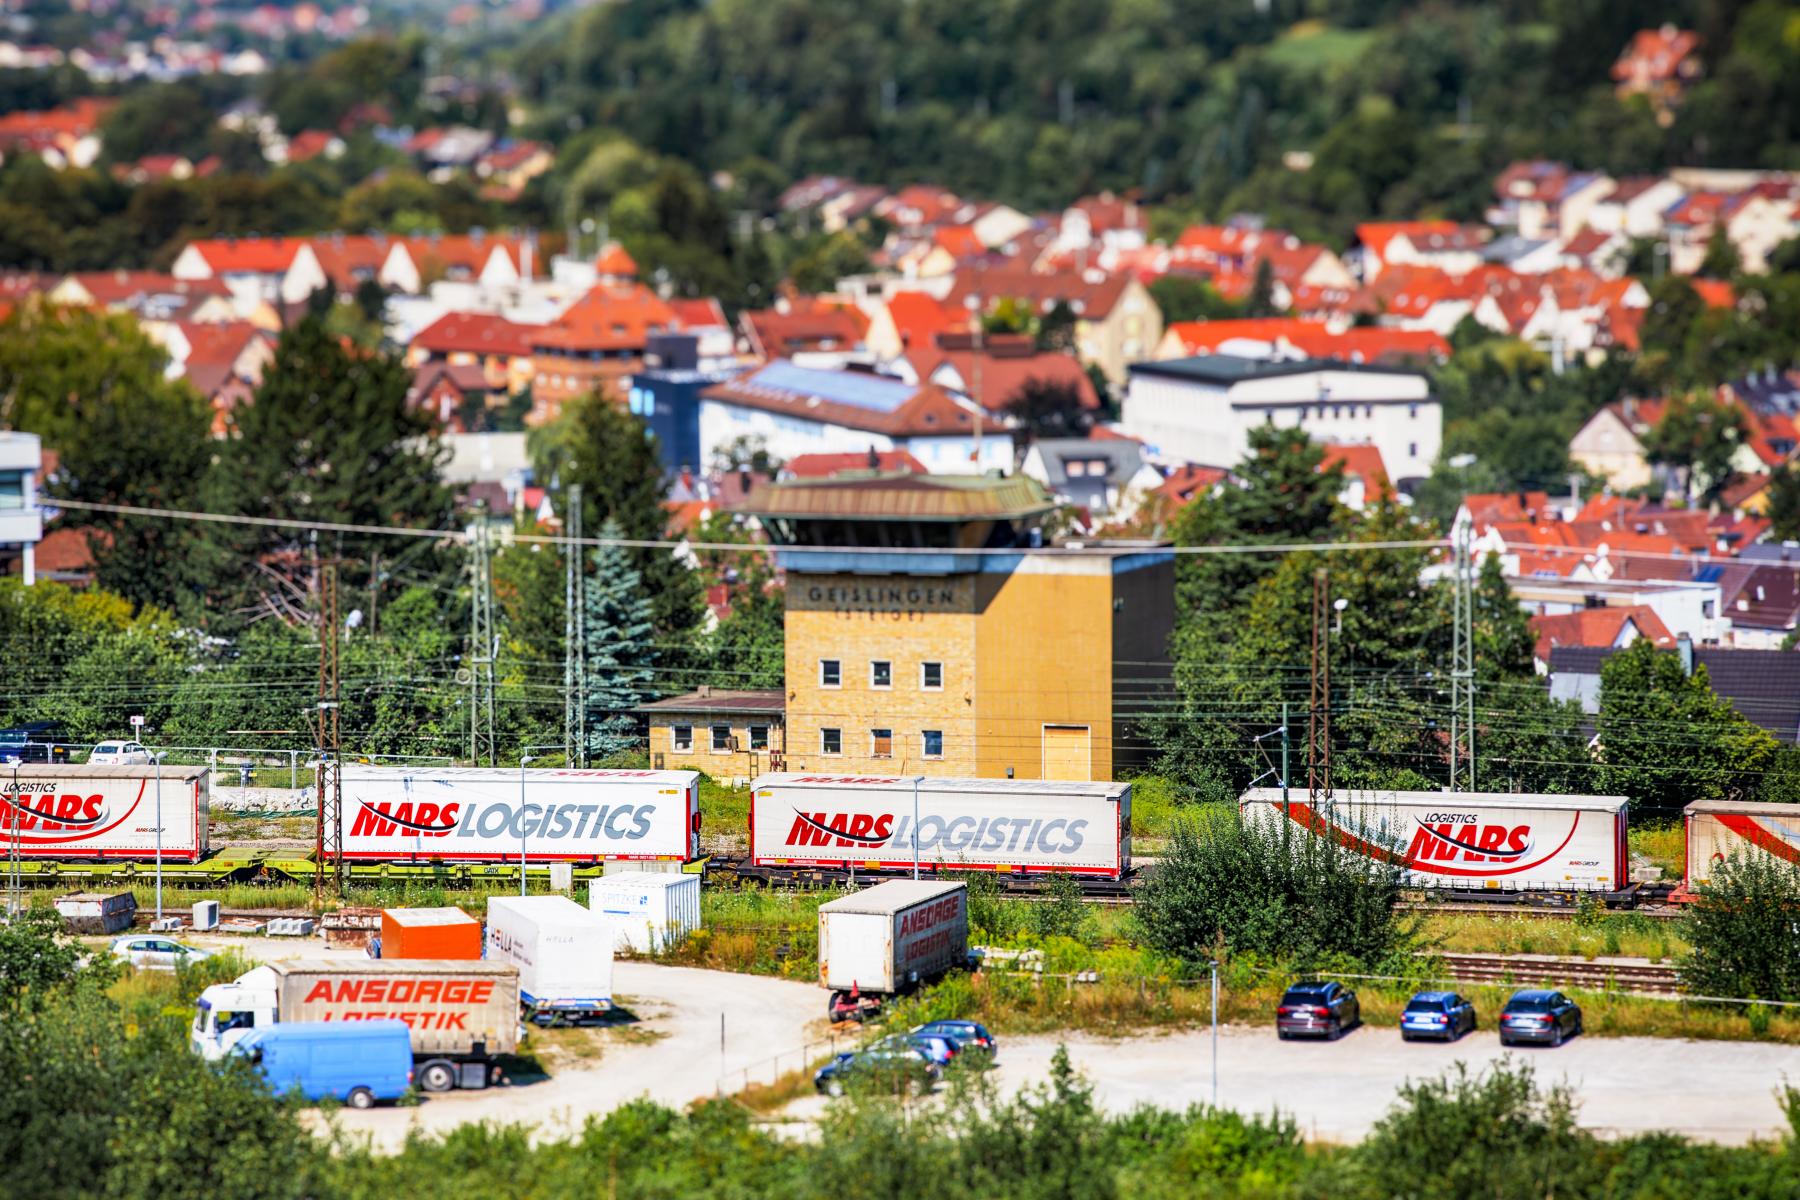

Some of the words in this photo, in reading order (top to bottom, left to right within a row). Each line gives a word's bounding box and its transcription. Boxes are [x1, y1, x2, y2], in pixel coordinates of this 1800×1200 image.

[809, 587, 953, 604] GEISLINGEN
[3, 783, 57, 793] LOGISTICS
[0, 794, 104, 830] MARS
[349, 802, 460, 837] MARS
[457, 803, 657, 840] LOGISTICS
[1424, 813, 1478, 823] LOGISTICS
[785, 813, 894, 849] MARS
[891, 815, 1089, 854] LOGISTICS
[1406, 823, 1531, 863] MARS
[899, 895, 960, 939] ANSORGE
[303, 980, 496, 1003] ANSORGE
